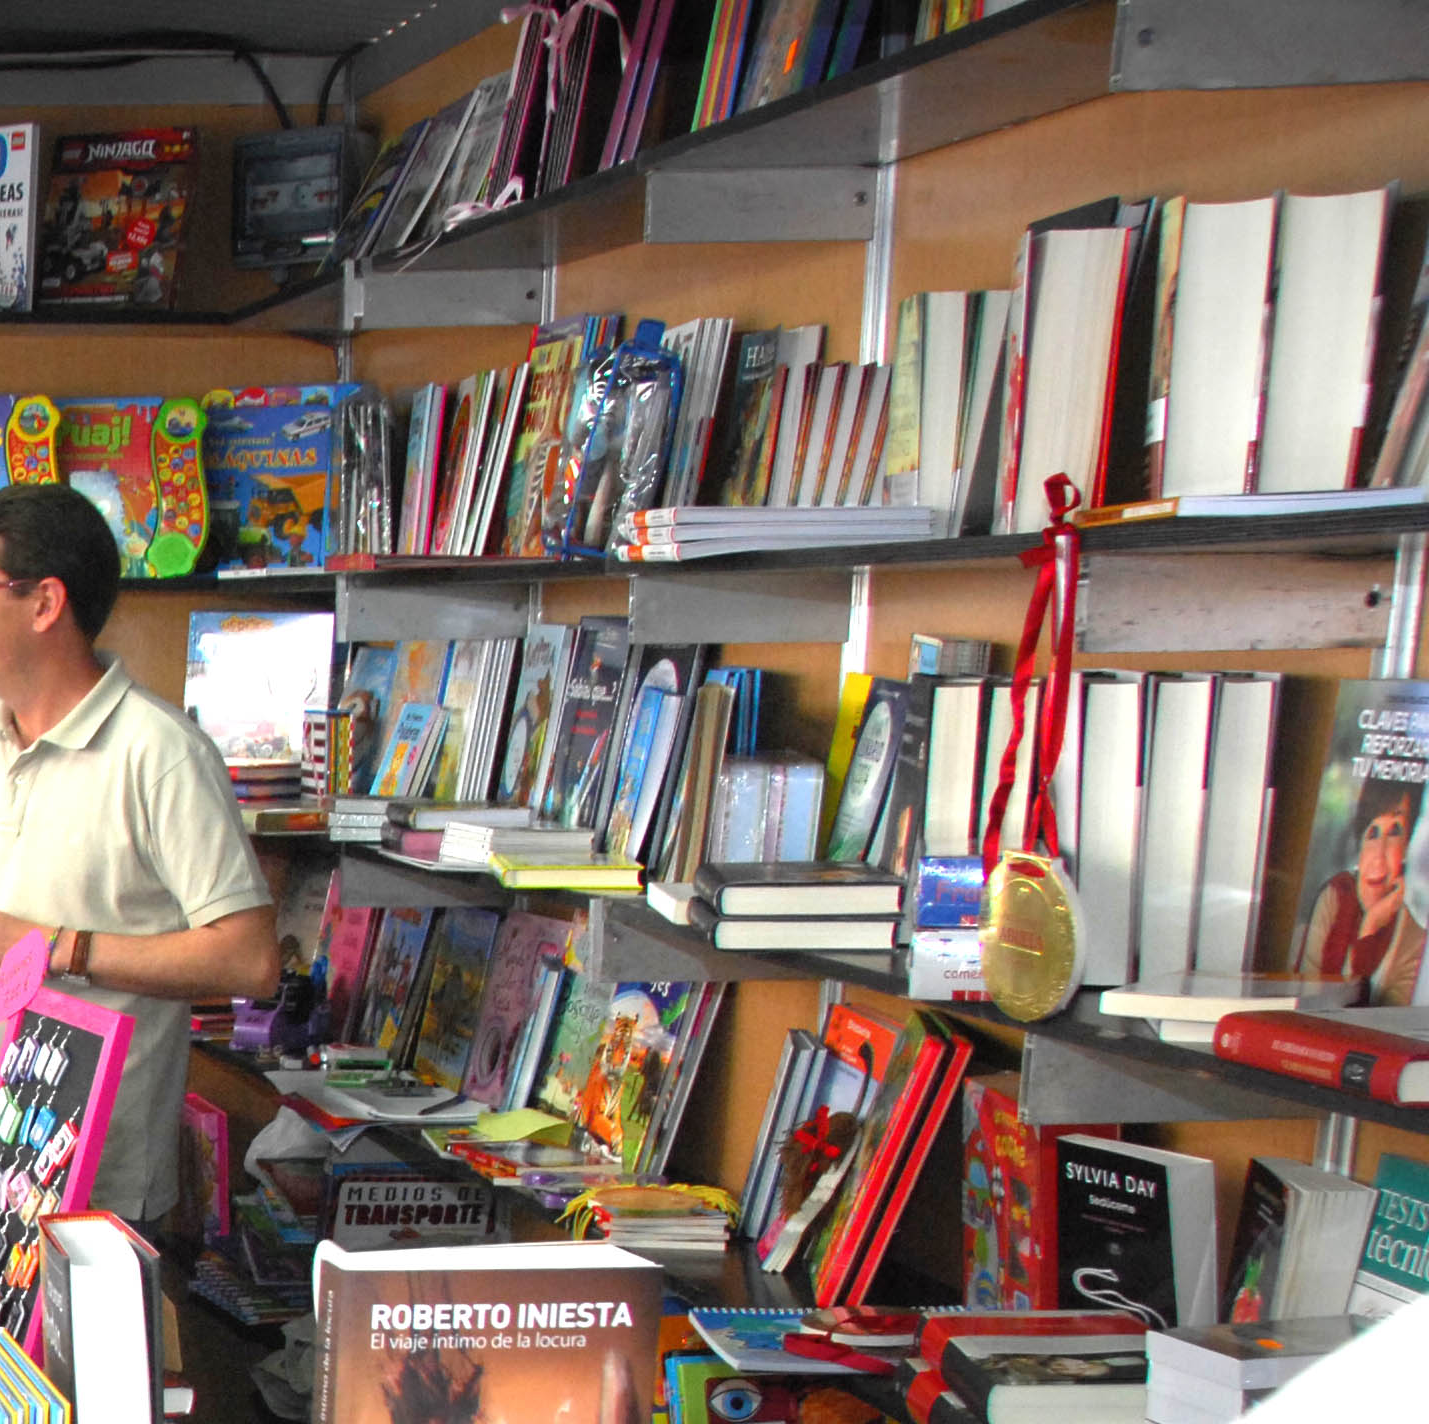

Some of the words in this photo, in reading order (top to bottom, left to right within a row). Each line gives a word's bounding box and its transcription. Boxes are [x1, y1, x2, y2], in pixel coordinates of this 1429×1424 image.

[1064, 1160, 1121, 1192] SYLVIA
[1124, 1174, 1159, 1201] DAY
[346, 1185, 445, 1203] MEDIOS
[456, 1185, 485, 1202] DE
[343, 1203, 485, 1227] TRANSPORTE
[370, 1303, 512, 1332] ROBERTO
[517, 1301, 634, 1330] INIESTA
[370, 1332, 385, 1351] El
[388, 1332, 429, 1355] viaje
[490, 1331, 513, 1350] de
[516, 1331, 532, 1349] la
[534, 1331, 588, 1349] locura
